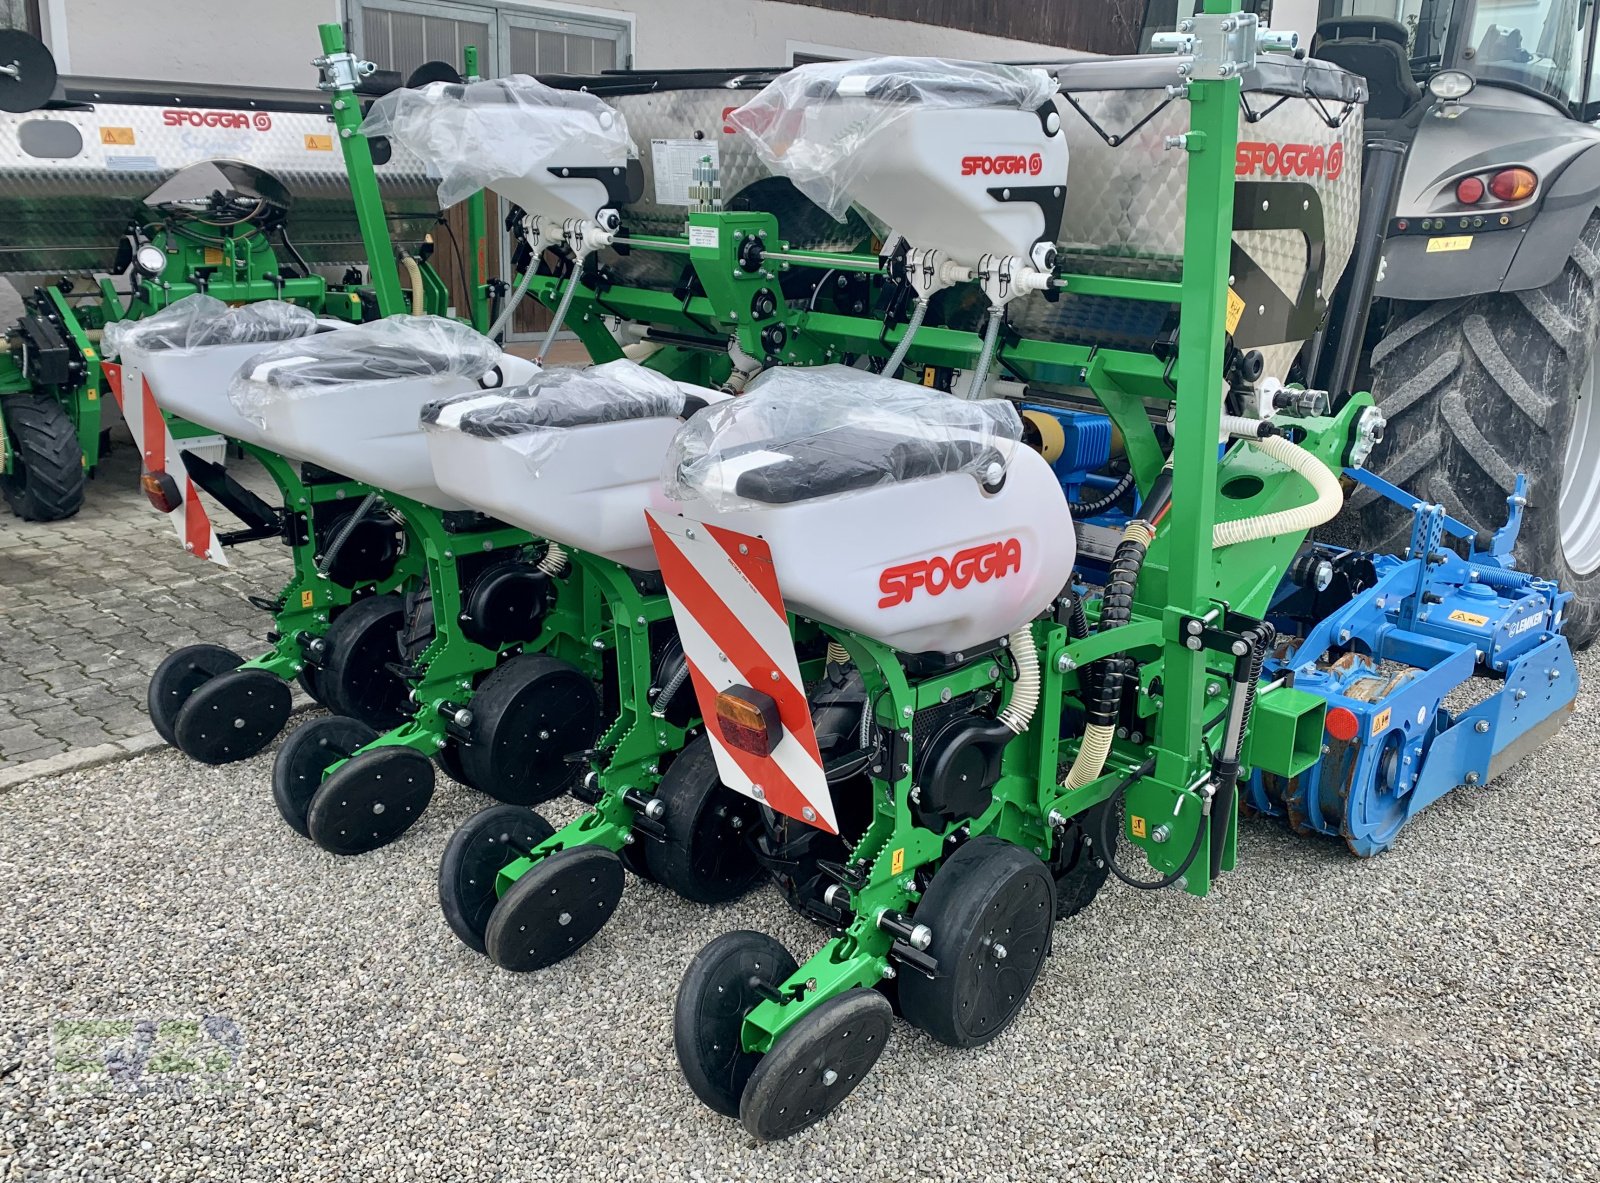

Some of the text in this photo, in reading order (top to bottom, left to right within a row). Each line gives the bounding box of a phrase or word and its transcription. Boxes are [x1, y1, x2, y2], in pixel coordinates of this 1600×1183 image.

[162, 110, 250, 129] SFOGGIA
[961, 155, 1027, 176] SFOGGIA
[1234, 141, 1325, 177] SFOGGIA
[877, 537, 1022, 609] SFOGGIA
[1515, 610, 1544, 635] LEMKEN
